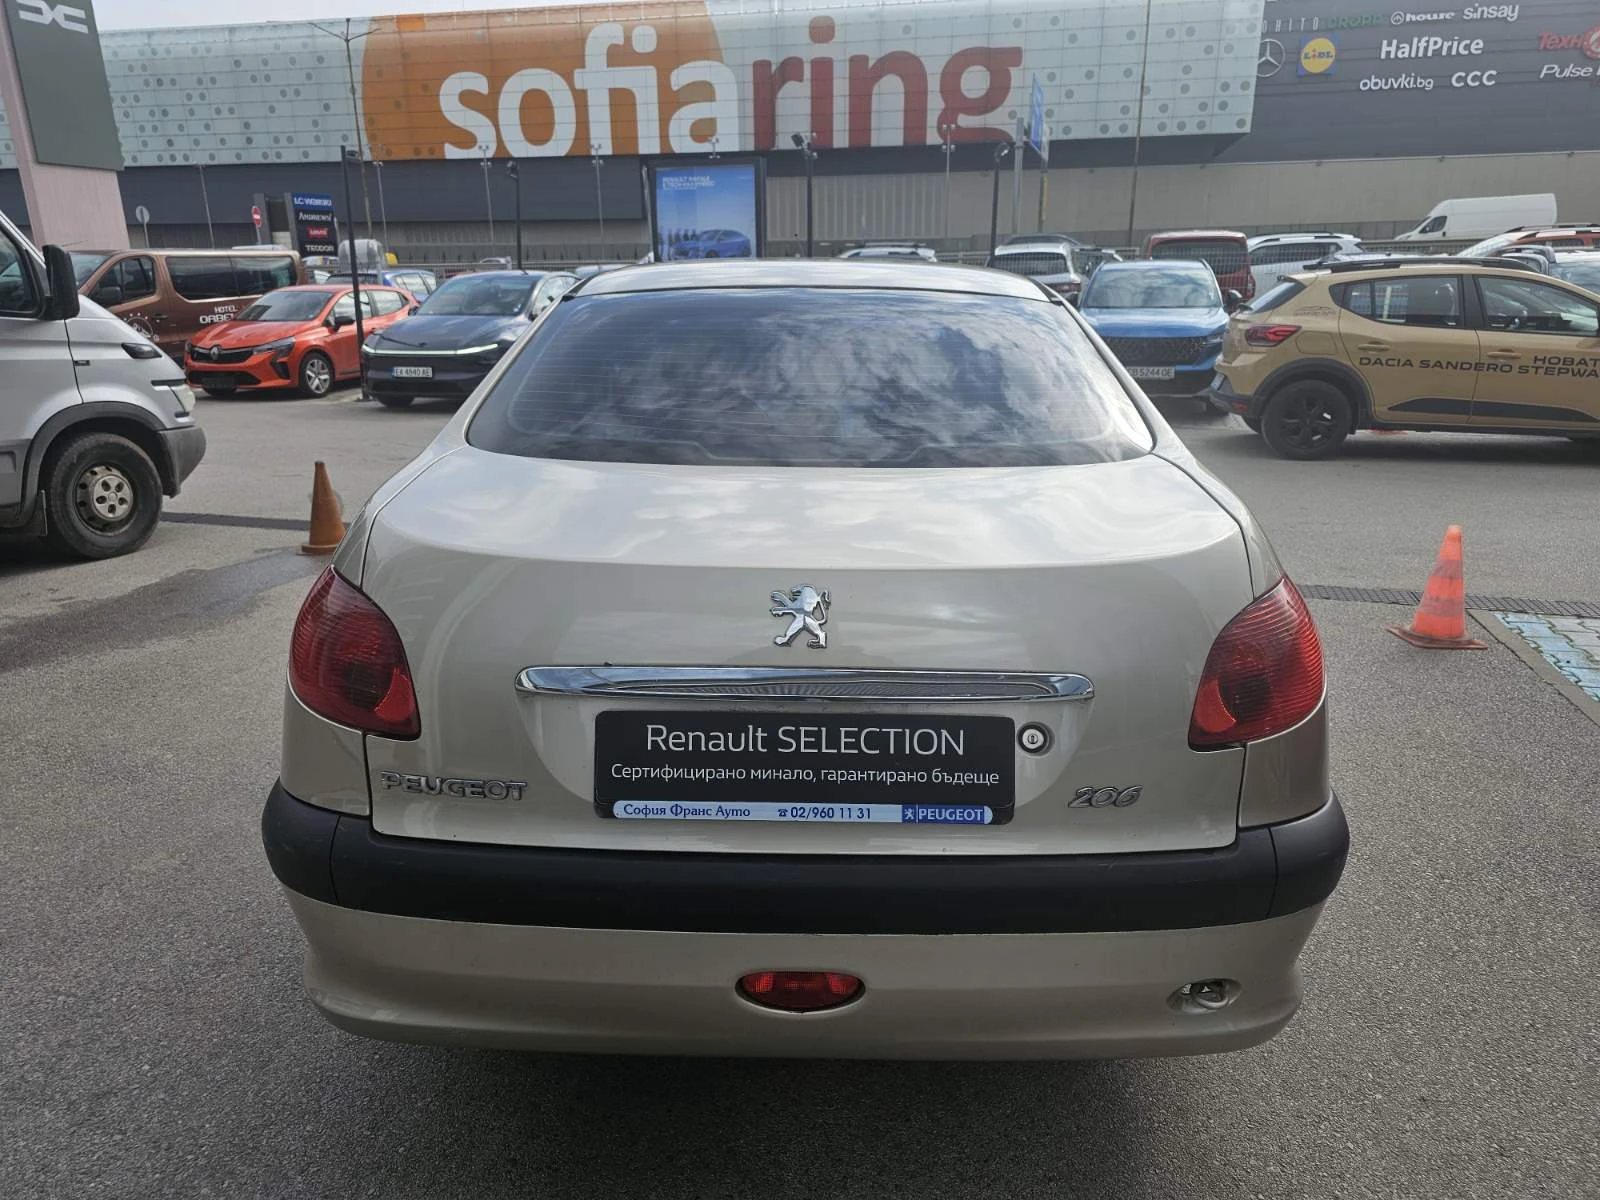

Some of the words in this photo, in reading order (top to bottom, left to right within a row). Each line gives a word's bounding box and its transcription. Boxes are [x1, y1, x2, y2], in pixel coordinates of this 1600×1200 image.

[1463, 3, 1519, 21] sinsay
[1380, 36, 1484, 59] HalfPrice
[1451, 70, 1497, 87] CCC
[1539, 64, 1593, 79] Pulse
[1359, 73, 1434, 91] obuvki.bg
[214, 305, 238, 313] HOTEL
[1359, 356, 1414, 368] DACIA
[1419, 359, 1513, 373] SANDERO
[646, 723, 768, 753] Renault
[777, 726, 965, 756] SELECTION
[611, 763, 746, 782] Сертифицирано
[750, 767, 817, 783] минало,
[821, 768, 928, 785] гарантирано
[932, 768, 1000, 786] бъдеще
[380, 770, 528, 801] PEUGEOT
[1067, 785, 1144, 808] 206
[623, 803, 666, 818] София
[670, 803, 713, 819] Франс
[790, 806, 835, 819] 02/960
[839, 807, 852, 819] 11
[856, 808, 871, 820] 31
[918, 808, 984, 821] PEUGEOT
